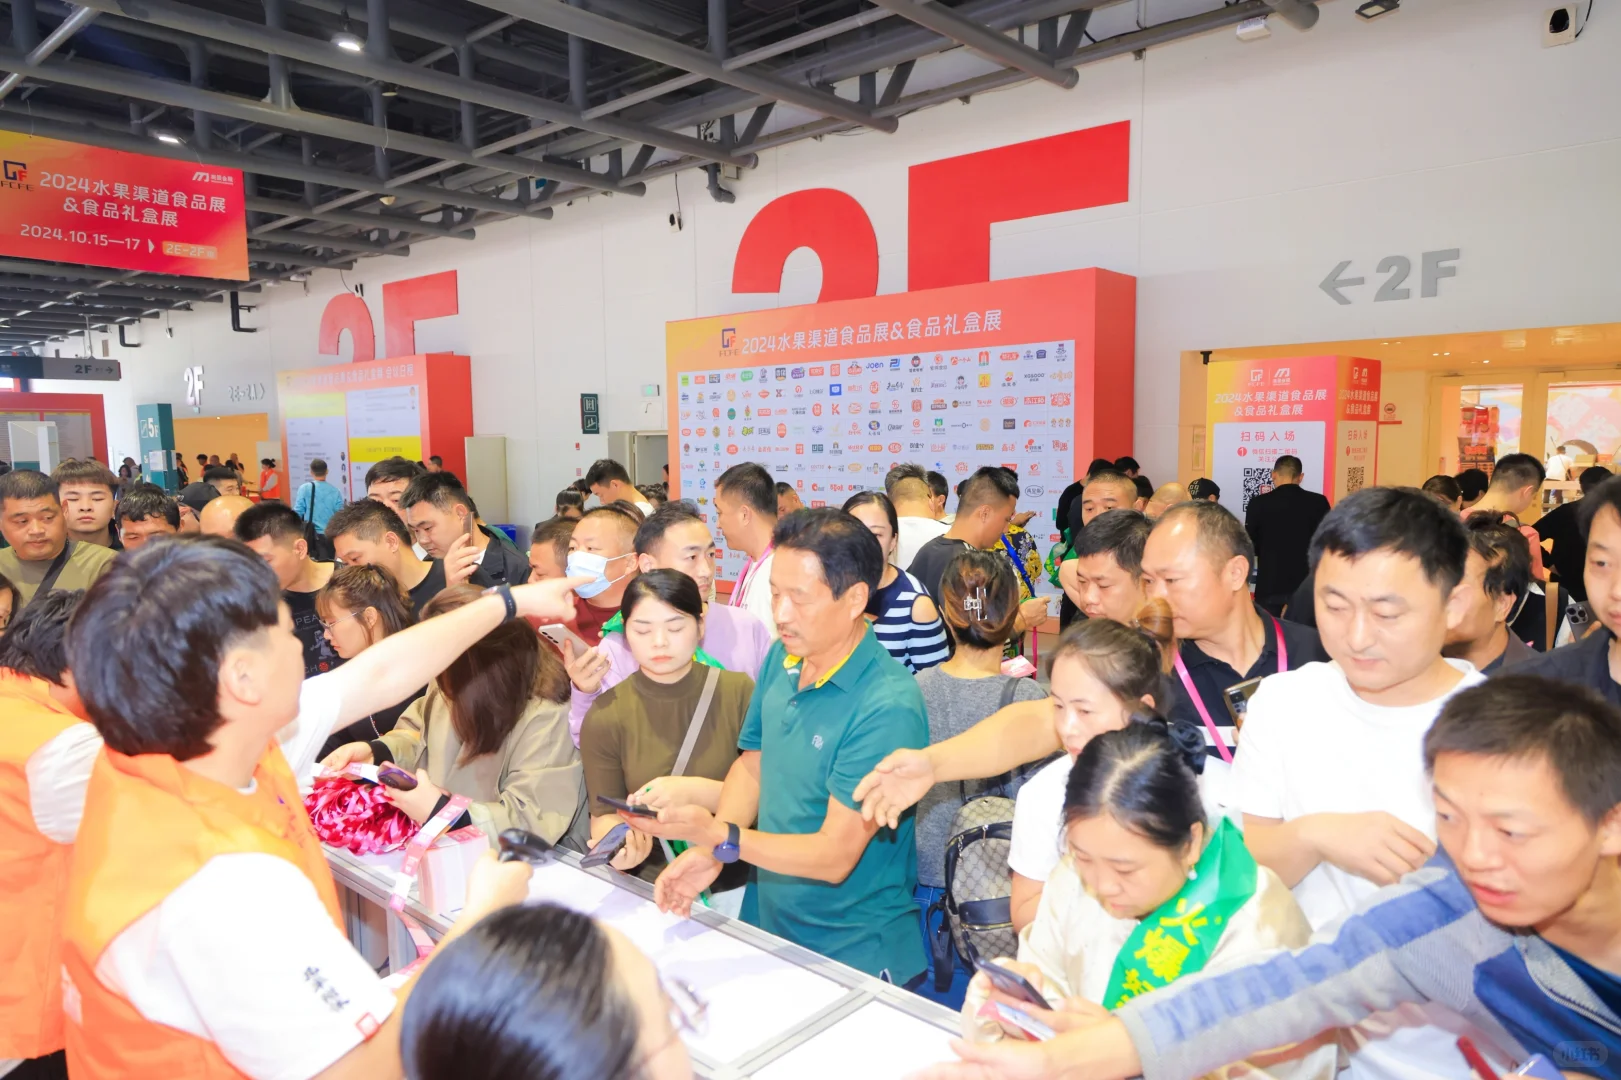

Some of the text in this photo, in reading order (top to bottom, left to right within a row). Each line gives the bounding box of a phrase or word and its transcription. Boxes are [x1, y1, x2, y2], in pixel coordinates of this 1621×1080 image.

[39, 171, 227, 213] 2024水果渠道食品展
[63, 196, 179, 228] &食品礼盒展
[1373, 247, 1461, 302] 2F
[741, 309, 1002, 355] 2024水果渠道食品展&食品礼盒展
[74, 364, 92, 374] 2F
[183, 365, 204, 406] 2F
[1214, 389, 1327, 404] 2024水果渠道食品展
[1234, 404, 1304, 417] &食品礼盒展
[1240, 430, 1295, 442] 扫码入场
